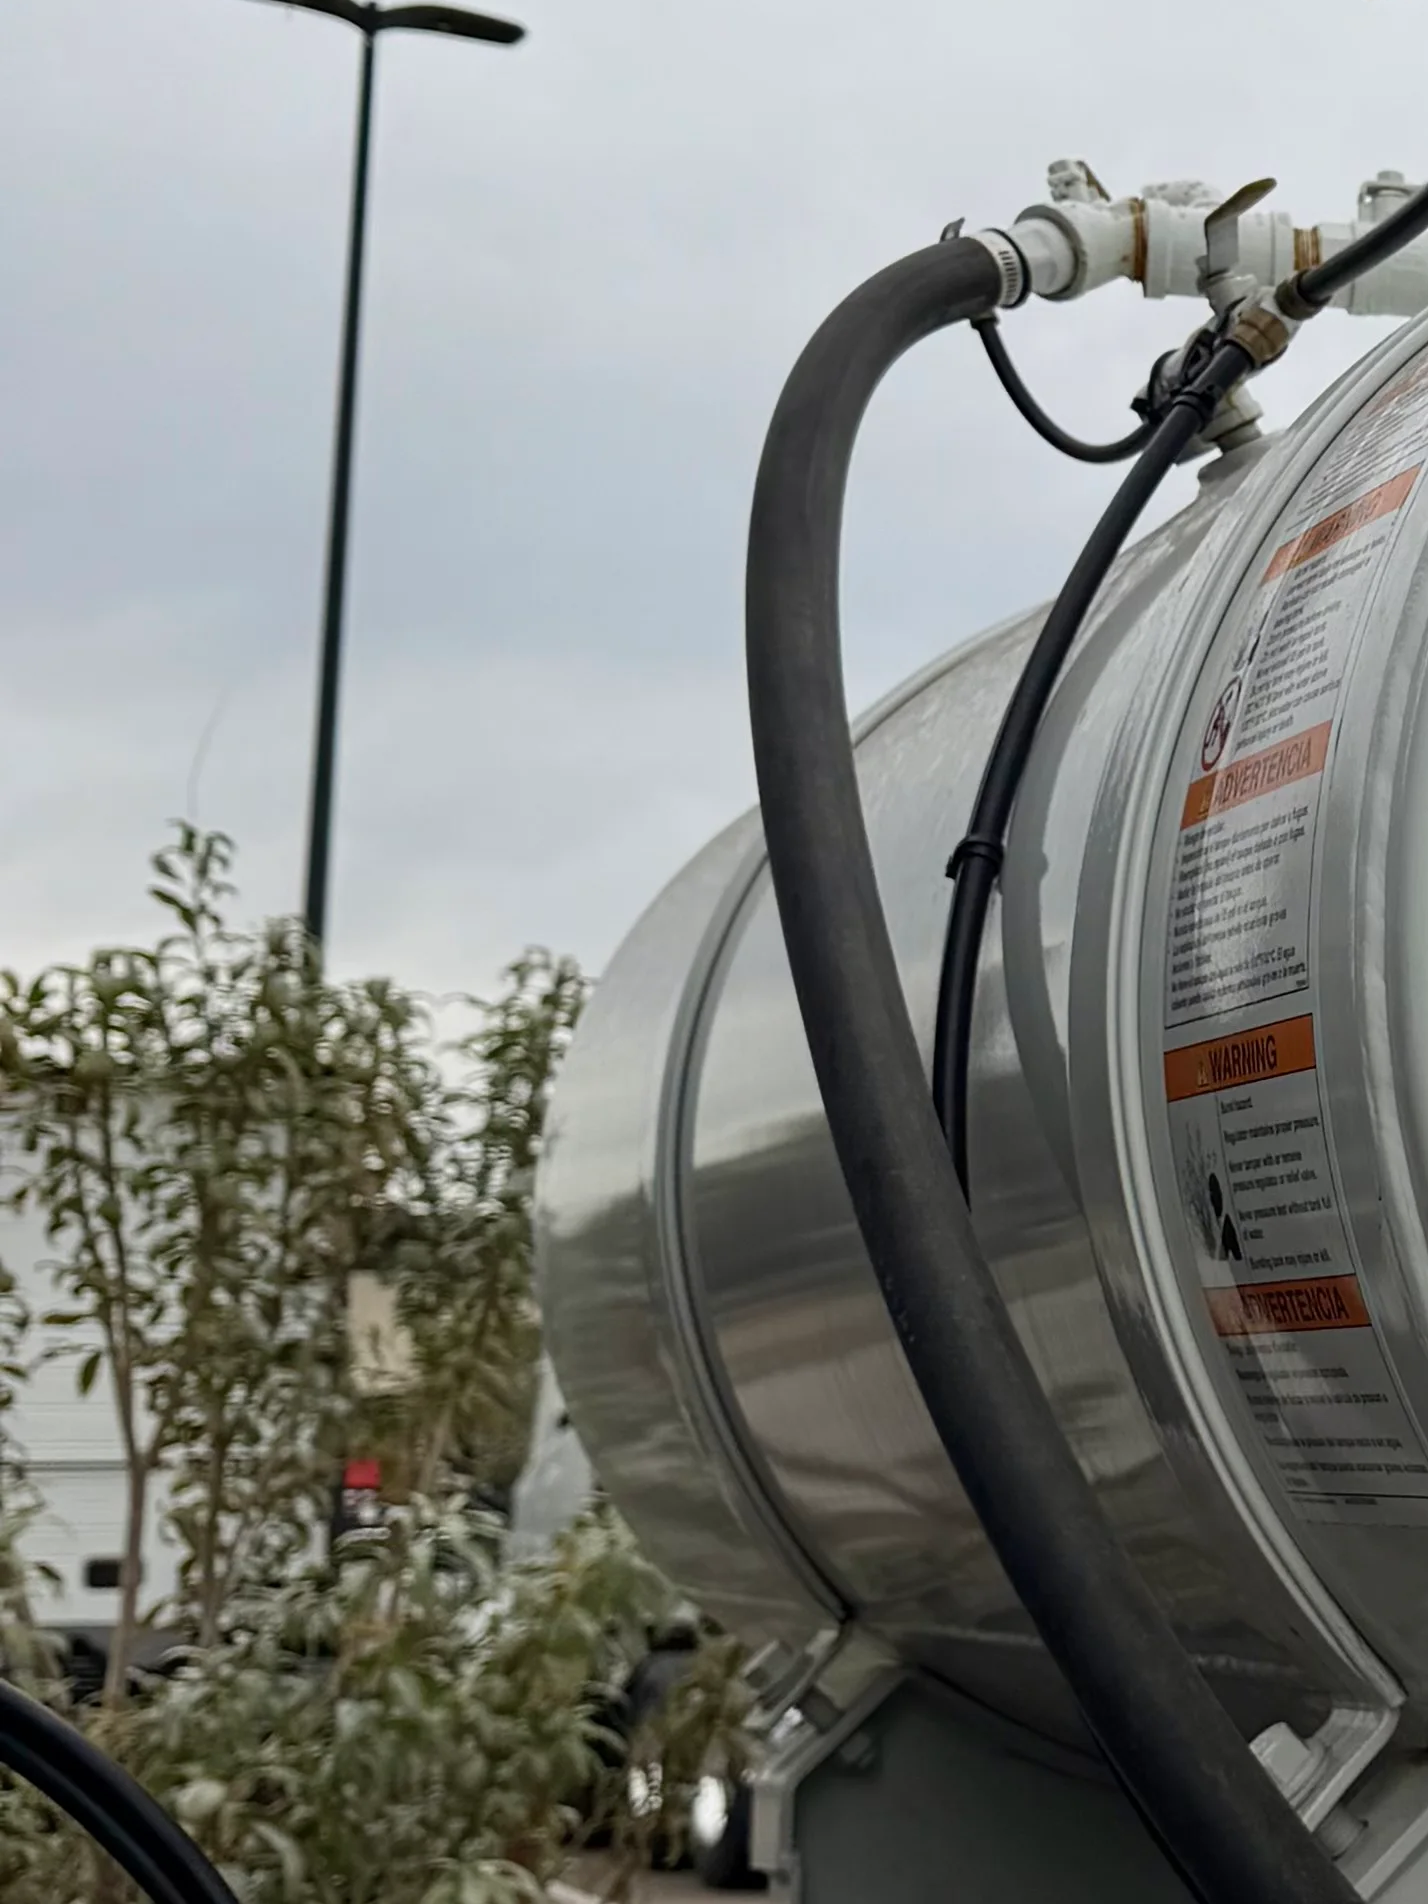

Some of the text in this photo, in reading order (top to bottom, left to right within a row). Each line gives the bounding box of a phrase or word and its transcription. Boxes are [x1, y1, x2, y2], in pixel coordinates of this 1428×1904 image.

[1214, 736, 1311, 807] ADVERTENCIA
[1209, 1035, 1277, 1081] WARNING
[1241, 1287, 1349, 1324] ADVERTENCIA
